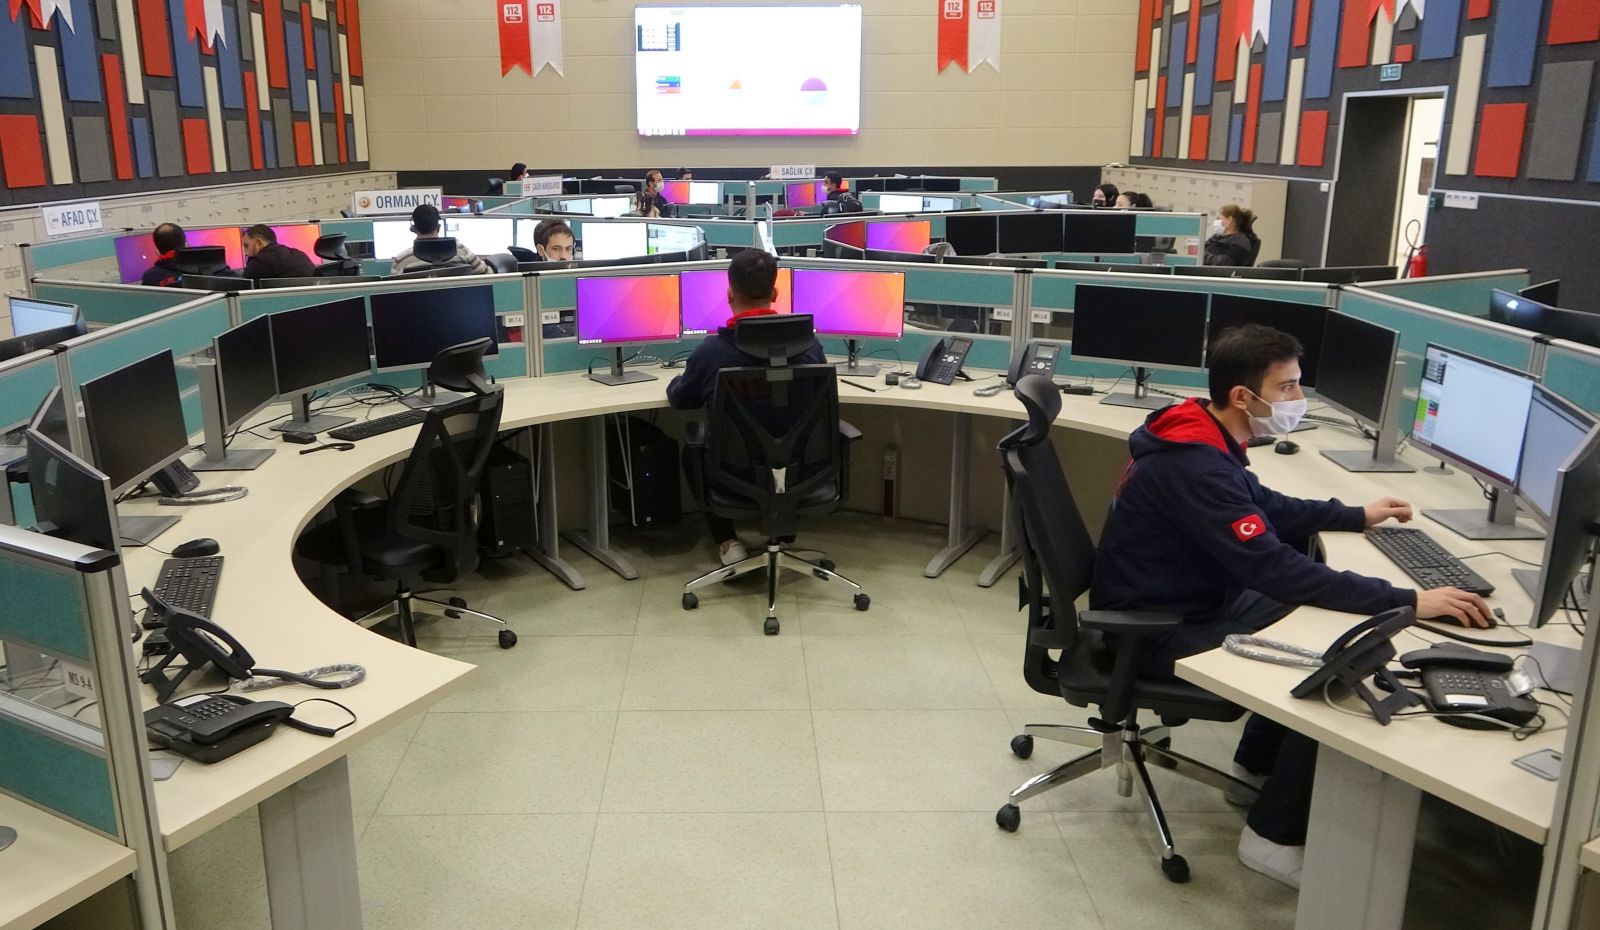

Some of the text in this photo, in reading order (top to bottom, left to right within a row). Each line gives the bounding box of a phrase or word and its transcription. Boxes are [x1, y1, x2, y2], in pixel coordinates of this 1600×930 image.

[506, 6, 519, 15] 112
[539, 5, 552, 14] 112
[948, 2, 960, 11] 112
[980, 2, 993, 11] 112
[781, 166, 803, 176] SAĞLIK
[376, 194, 419, 208] ORMAN
[61, 210, 84, 227] AFAD
